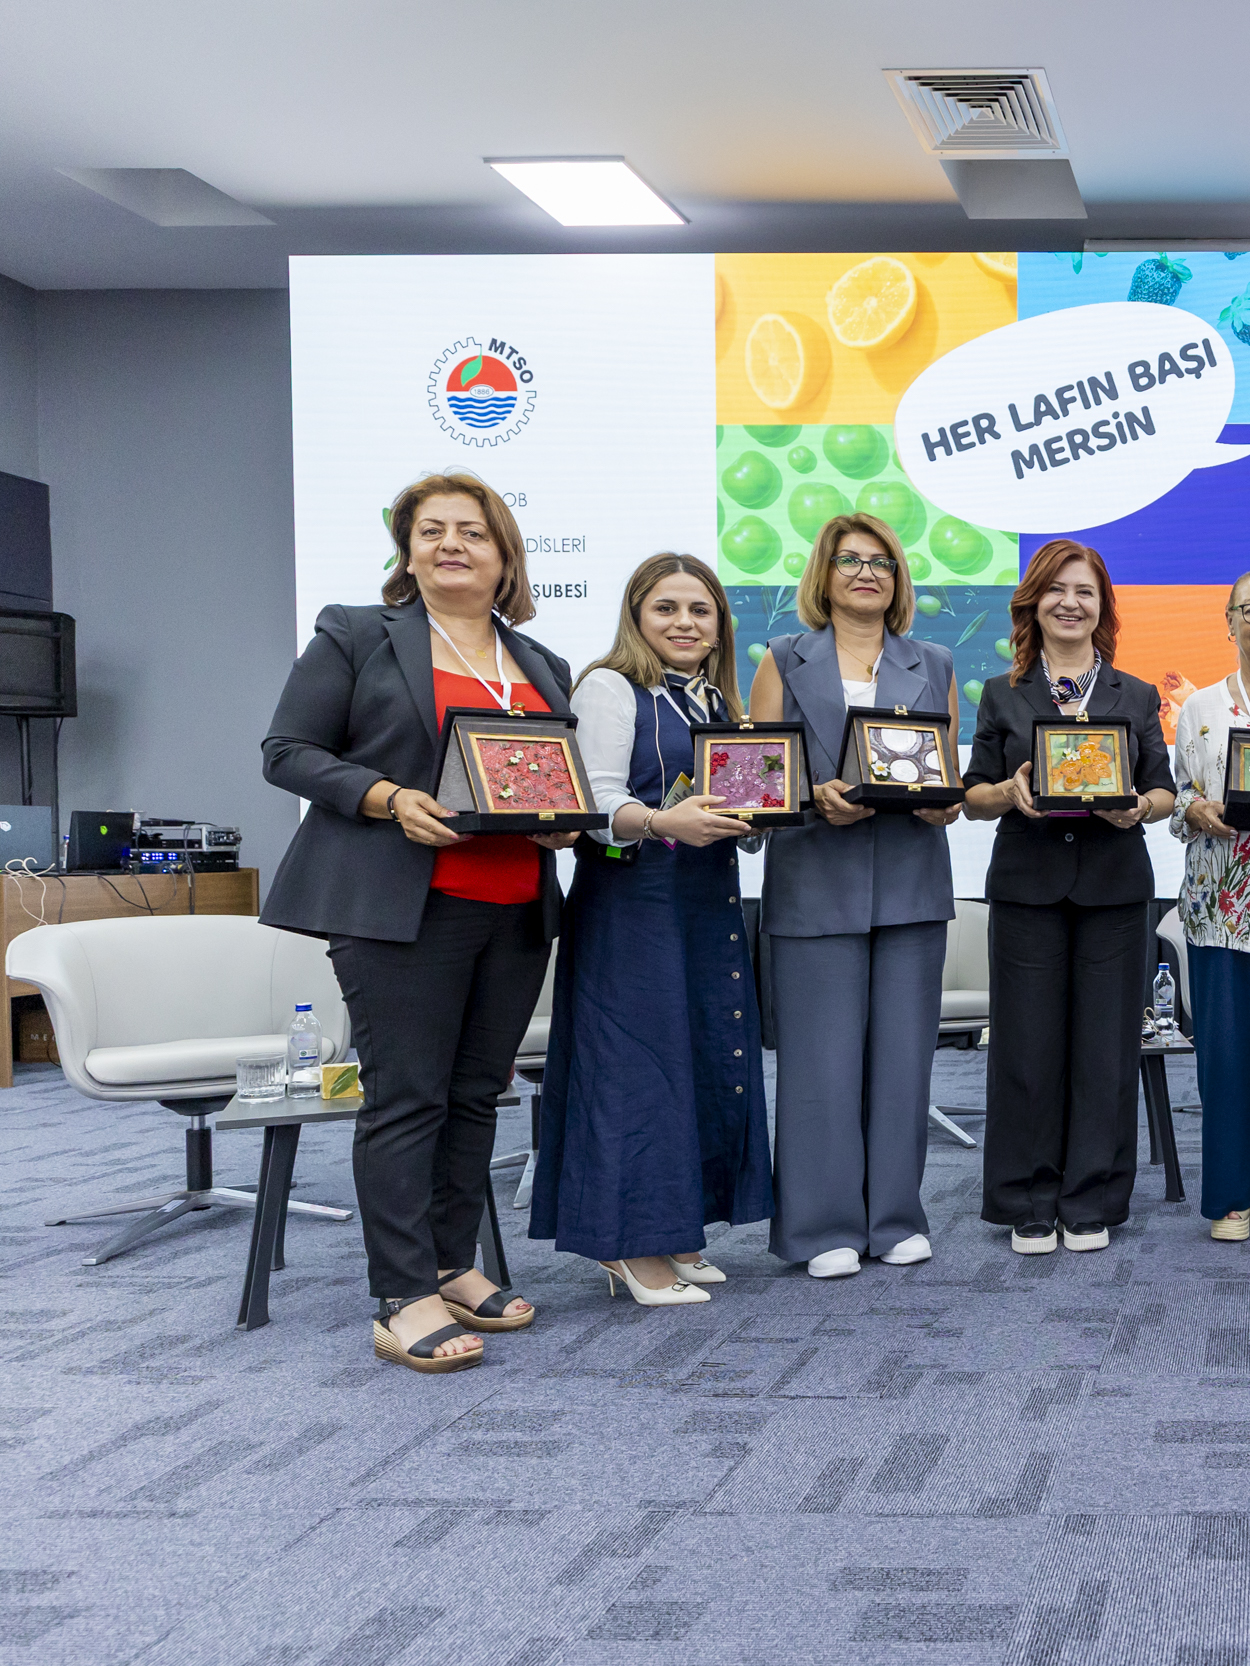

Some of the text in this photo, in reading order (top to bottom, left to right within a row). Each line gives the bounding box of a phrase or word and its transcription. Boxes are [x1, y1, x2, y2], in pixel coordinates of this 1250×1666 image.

[488, 337, 534, 384] MTSO
[921, 337, 1218, 462] HER LAFIN BAŞI
[1010, 405, 1156, 480] MERSİN
[532, 580, 588, 601] ŞUBESİ
